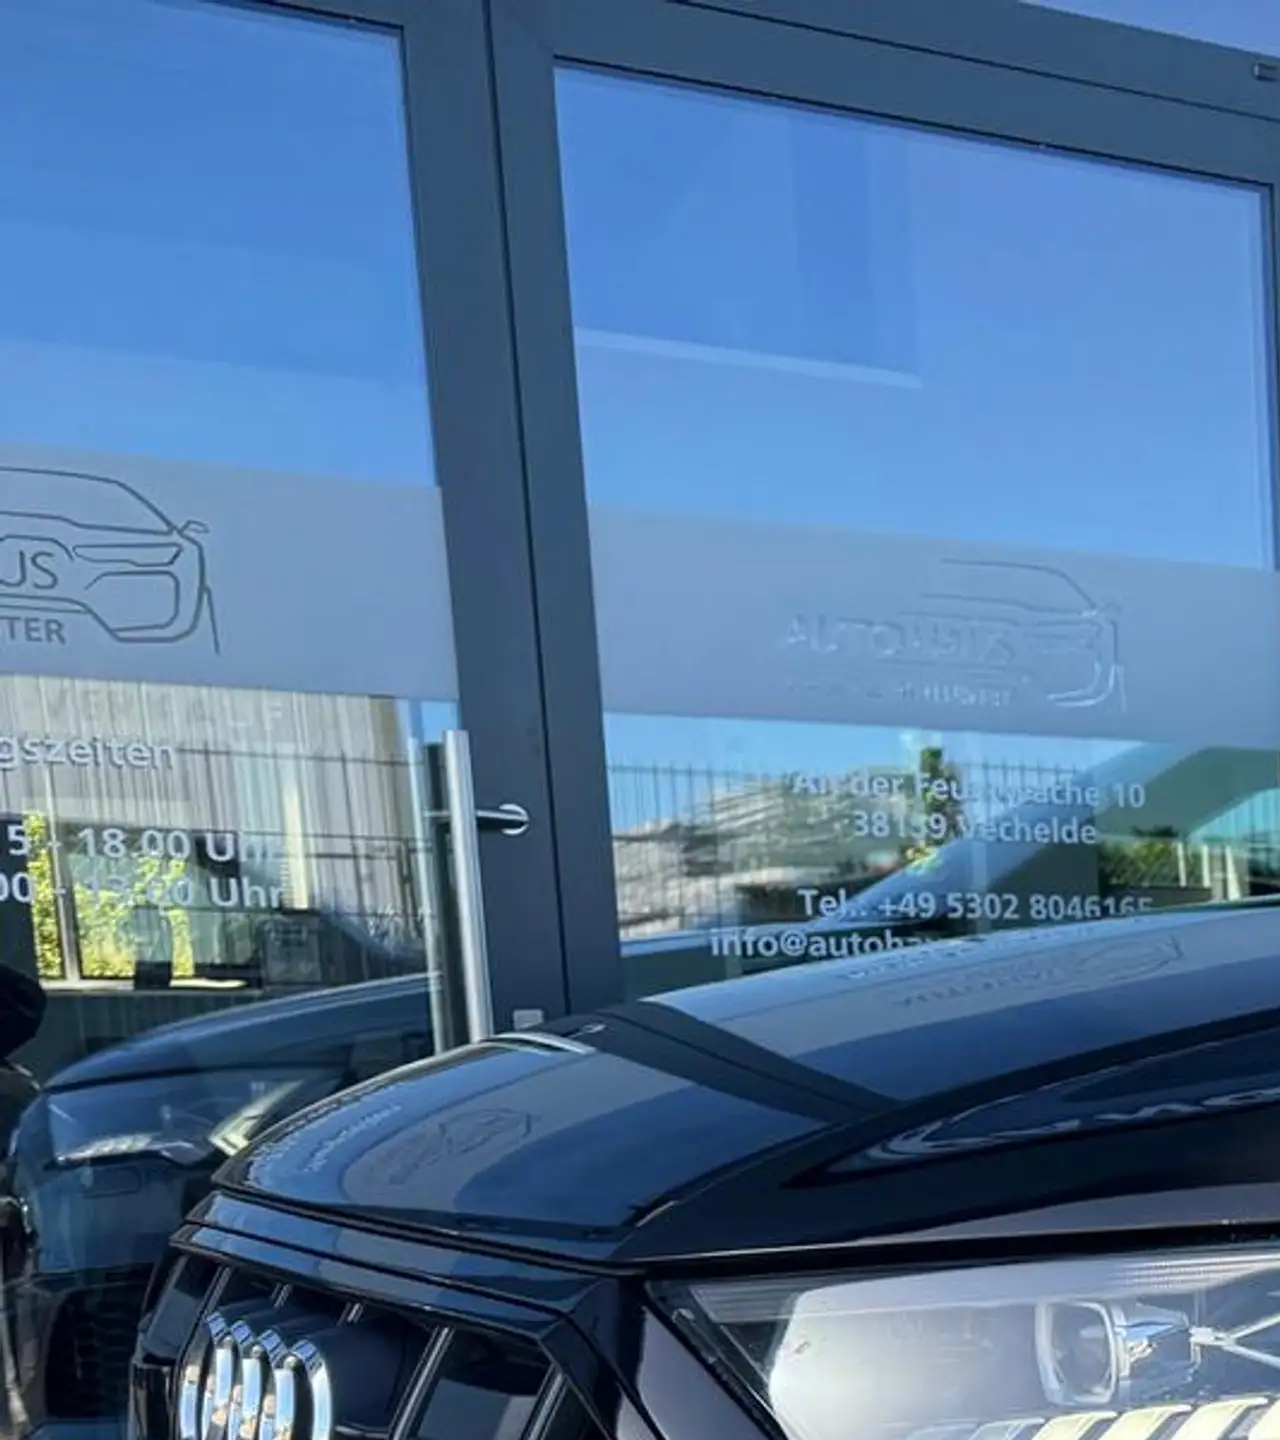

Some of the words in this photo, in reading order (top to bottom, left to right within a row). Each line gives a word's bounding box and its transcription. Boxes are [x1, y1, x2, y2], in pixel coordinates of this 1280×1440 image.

[850, 772, 904, 796] der
[1113, 783, 1147, 809] 10
[207, 874, 284, 909] Uhr
[878, 891, 937, 919] +49
[945, 892, 1019, 920] 5302
